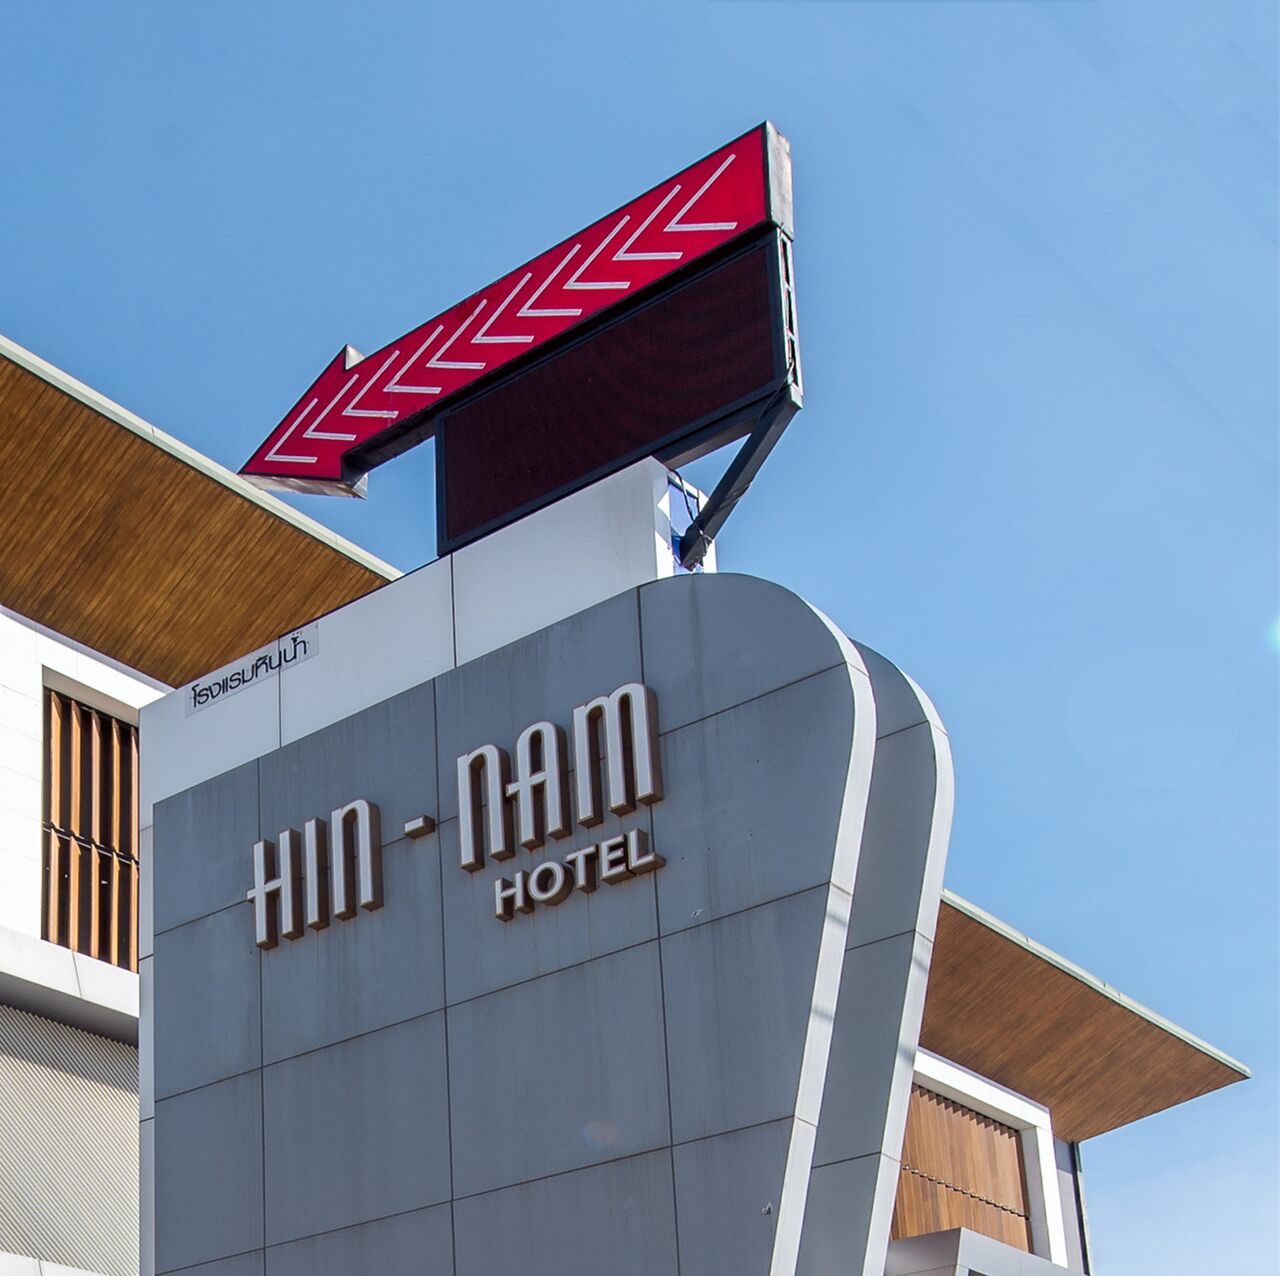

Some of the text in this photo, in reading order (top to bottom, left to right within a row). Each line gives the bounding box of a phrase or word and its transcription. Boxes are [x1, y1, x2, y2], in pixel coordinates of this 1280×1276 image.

[247, 799, 384, 950] HIN
[458, 683, 663, 873] NAM
[495, 828, 665, 921] HOTEL
